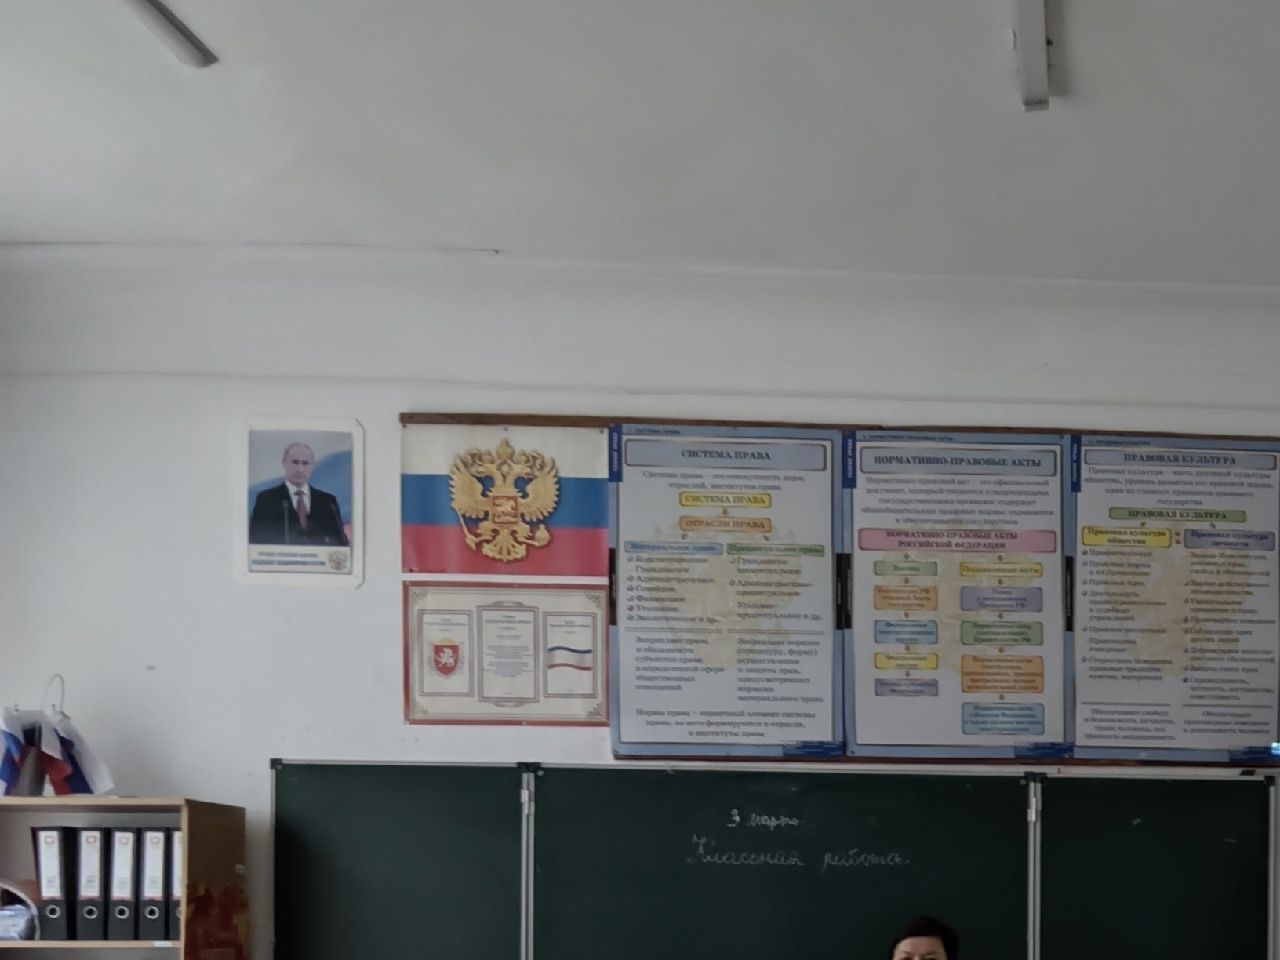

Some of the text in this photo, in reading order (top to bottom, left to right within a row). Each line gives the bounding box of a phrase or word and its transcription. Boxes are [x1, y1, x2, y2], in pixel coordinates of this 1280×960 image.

[681, 449, 771, 460] СИСТЕМА ПРАВА
[1124, 453, 1237, 465] ПРАВОВАЯ КУЛЬТУРА
[874, 455, 1042, 467] НОРМАТИВНО-ПРАВОВЫЕ АКТЫ
[685, 495, 766, 504] СИСТЕМА ПРАВА
[1128, 510, 1227, 519] ПРАВОВАЯ КУЛЬТУРА
[685, 519, 766, 529] ОТРАСЛИ ПРАВА
[994, 532, 1018, 540] АКТЫ
[898, 539, 1006, 549] РОССИЙСКОЙ ФЕДЕРАЦИИ
[726, 808, 741, 828] 3
